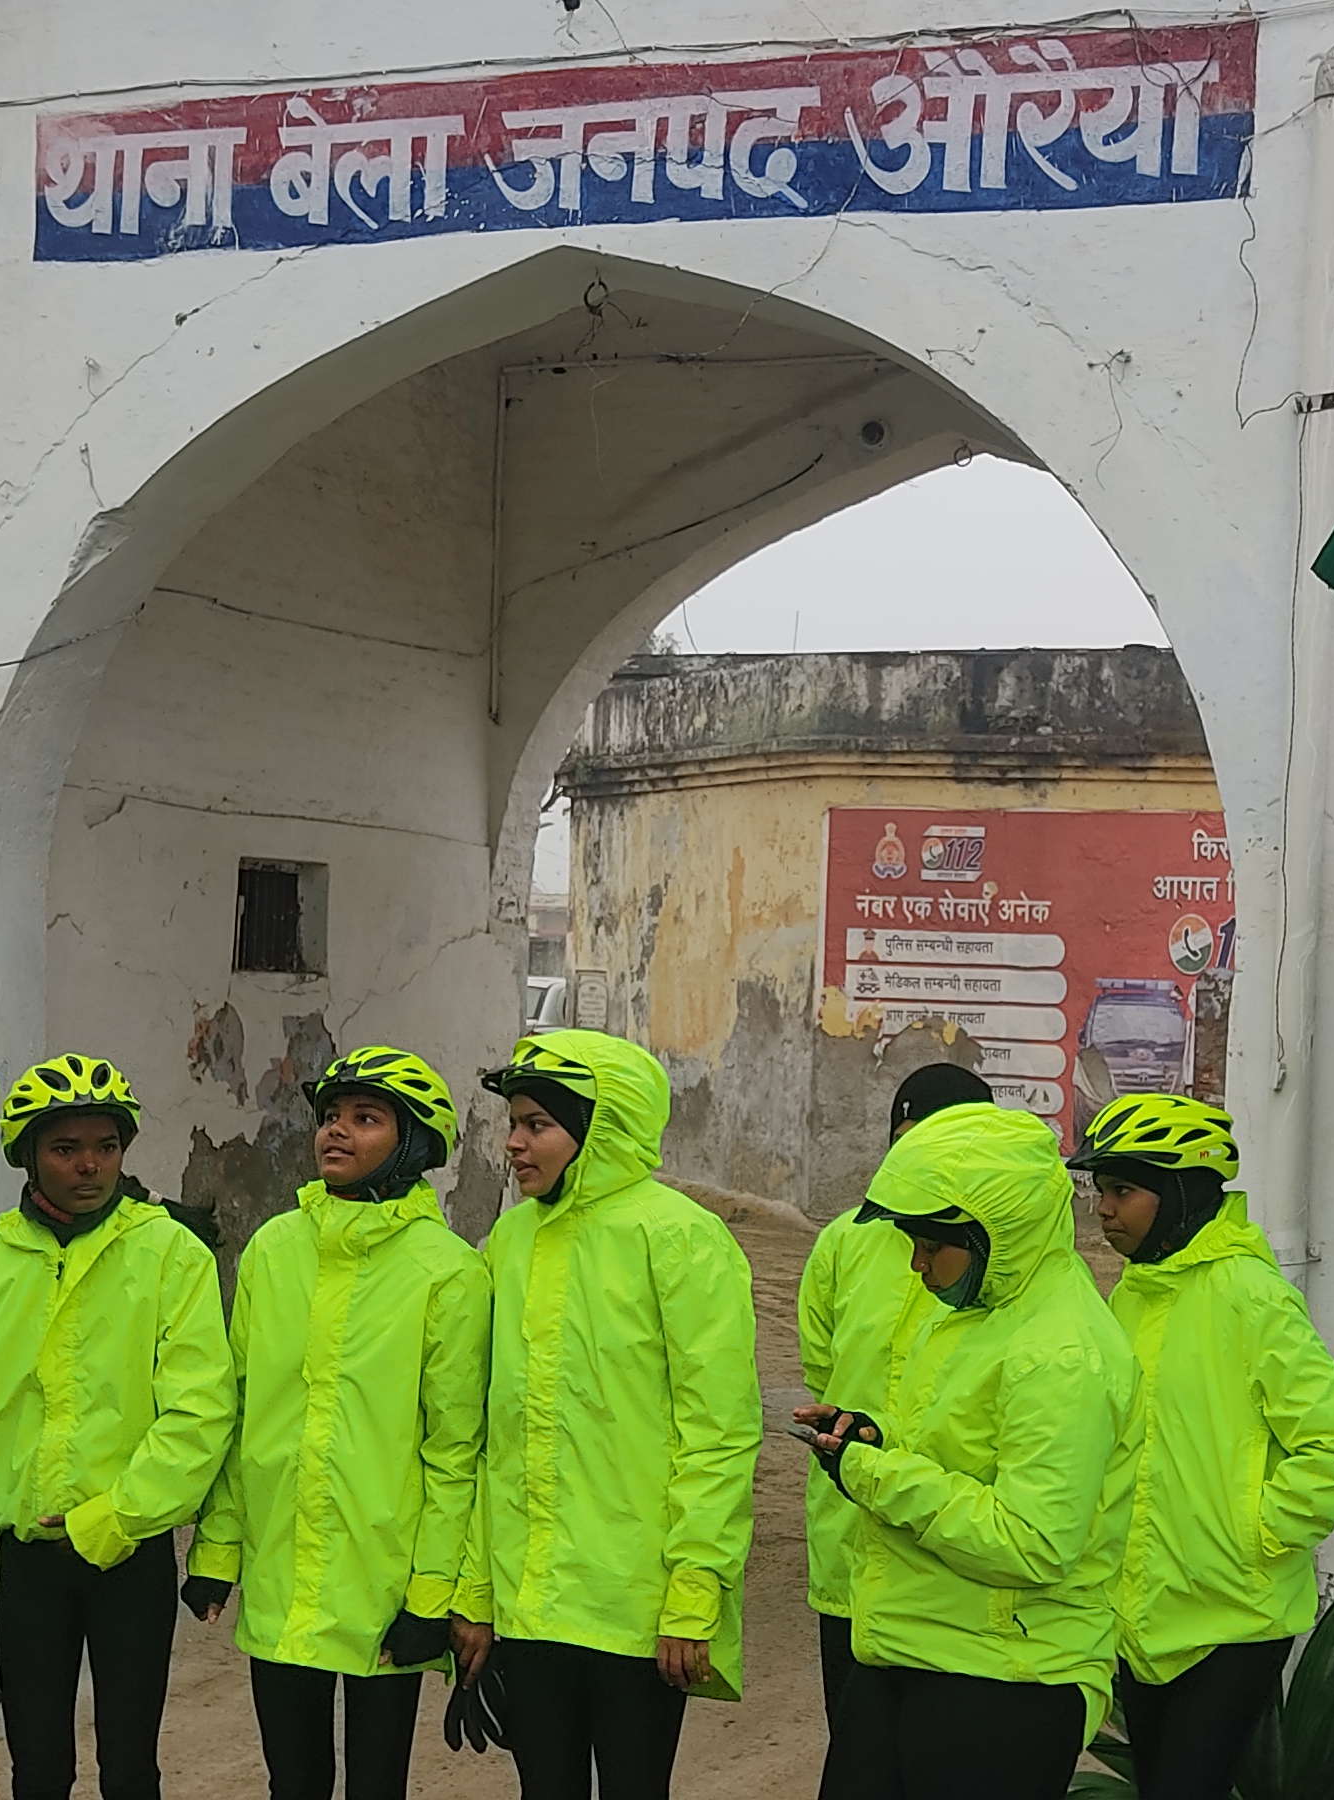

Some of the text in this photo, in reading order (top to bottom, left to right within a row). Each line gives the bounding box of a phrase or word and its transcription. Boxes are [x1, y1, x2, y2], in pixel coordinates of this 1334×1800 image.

[44, 39, 1221, 236] थाना बेला जनपद औरैया
[943, 838, 985, 870] 112
[1153, 875, 1221, 902] आपात
[855, 888, 898, 919] नंबर
[901, 896, 934, 924] एक
[998, 890, 1052, 923] अनेक
[885, 935, 994, 956] पुलिस सम्बन्धी सहायता
[884, 971, 1002, 993] मेडिकल सम्बन्धी सहायता
